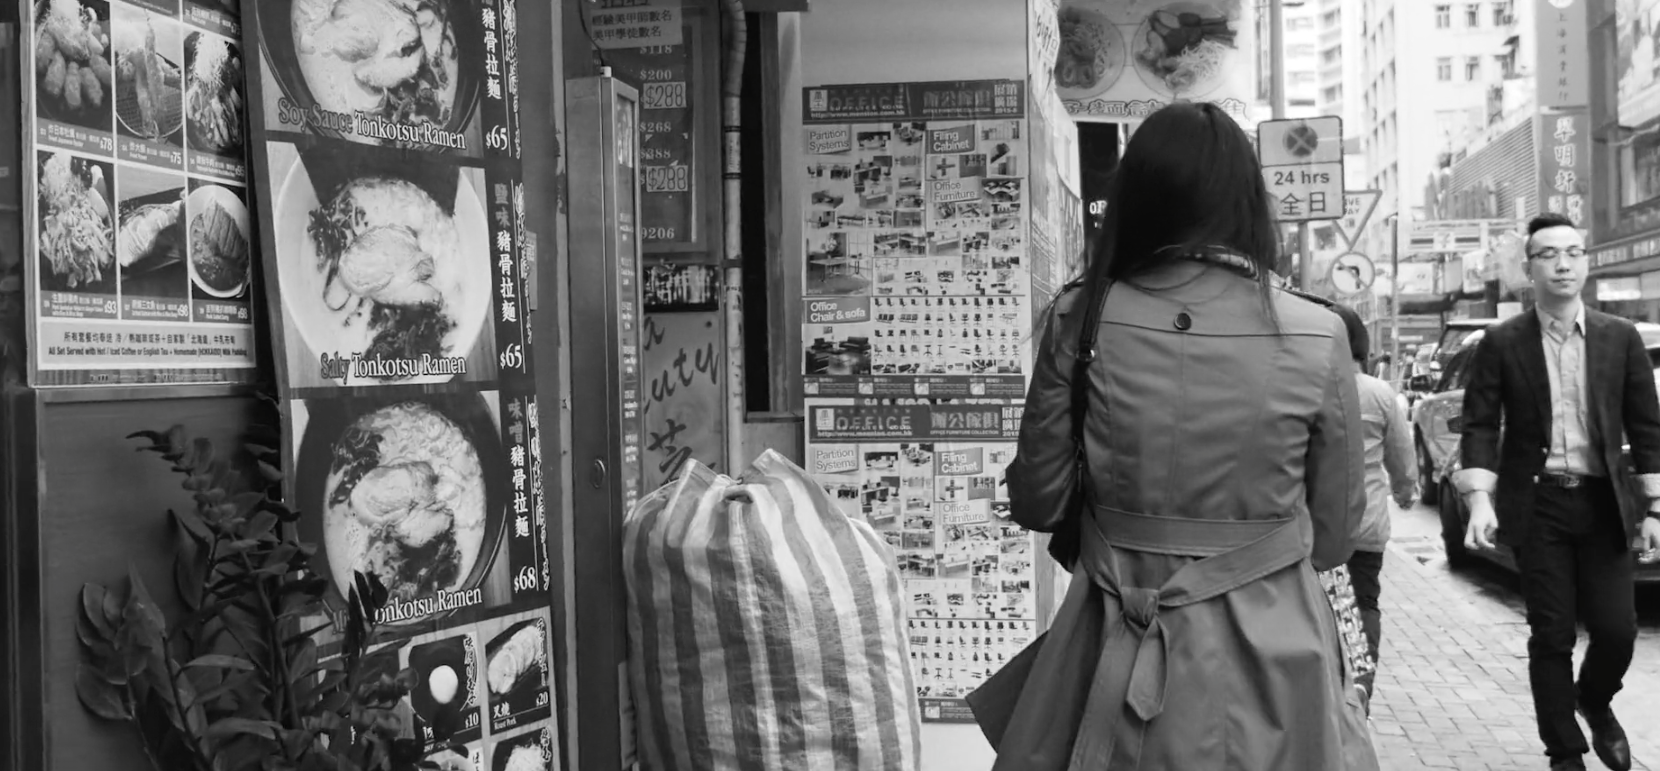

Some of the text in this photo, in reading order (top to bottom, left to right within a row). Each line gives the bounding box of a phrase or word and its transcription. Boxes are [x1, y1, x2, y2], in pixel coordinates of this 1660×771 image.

[640, 70, 672, 80] $200
[645, 84, 684, 108] $288
[278, 98, 466, 149] Soy Sauce Tonkotsu Ramen
[639, 122, 672, 133] $268
[486, 125, 508, 151] $65
[809, 129, 847, 140] Partition
[933, 131, 959, 143] Filing
[100, 137, 112, 151] $78
[809, 140, 849, 151] Systems
[933, 139, 969, 151] Cabinet
[170, 151, 181, 165] $75
[648, 167, 687, 190] $288
[1274, 171, 1330, 185] 24 hrs
[934, 180, 961, 191] Office
[934, 190, 975, 201] Furniture
[1280, 192, 1326, 215] 全日
[810, 301, 837, 312] Office
[810, 308, 866, 322] Chair & sofa
[500, 343, 522, 369] $65
[320, 351, 466, 385] Salty Tonkotsu Ramen
[645, 343, 720, 414] uty
[836, 416, 912, 429] OFFICE
[816, 449, 854, 459] Partition
[941, 452, 967, 463] Filing
[816, 460, 856, 471] Systems
[941, 462, 978, 473] Cabinet
[942, 503, 970, 513] Office
[942, 512, 985, 523] Furniture
[514, 566, 537, 593] $68
[372, 599, 434, 626] onkotsu
[436, 587, 483, 613] Ramen
[536, 691, 548, 707] $20
[465, 712, 479, 729] $10
[506, 717, 516, 728] Pork
